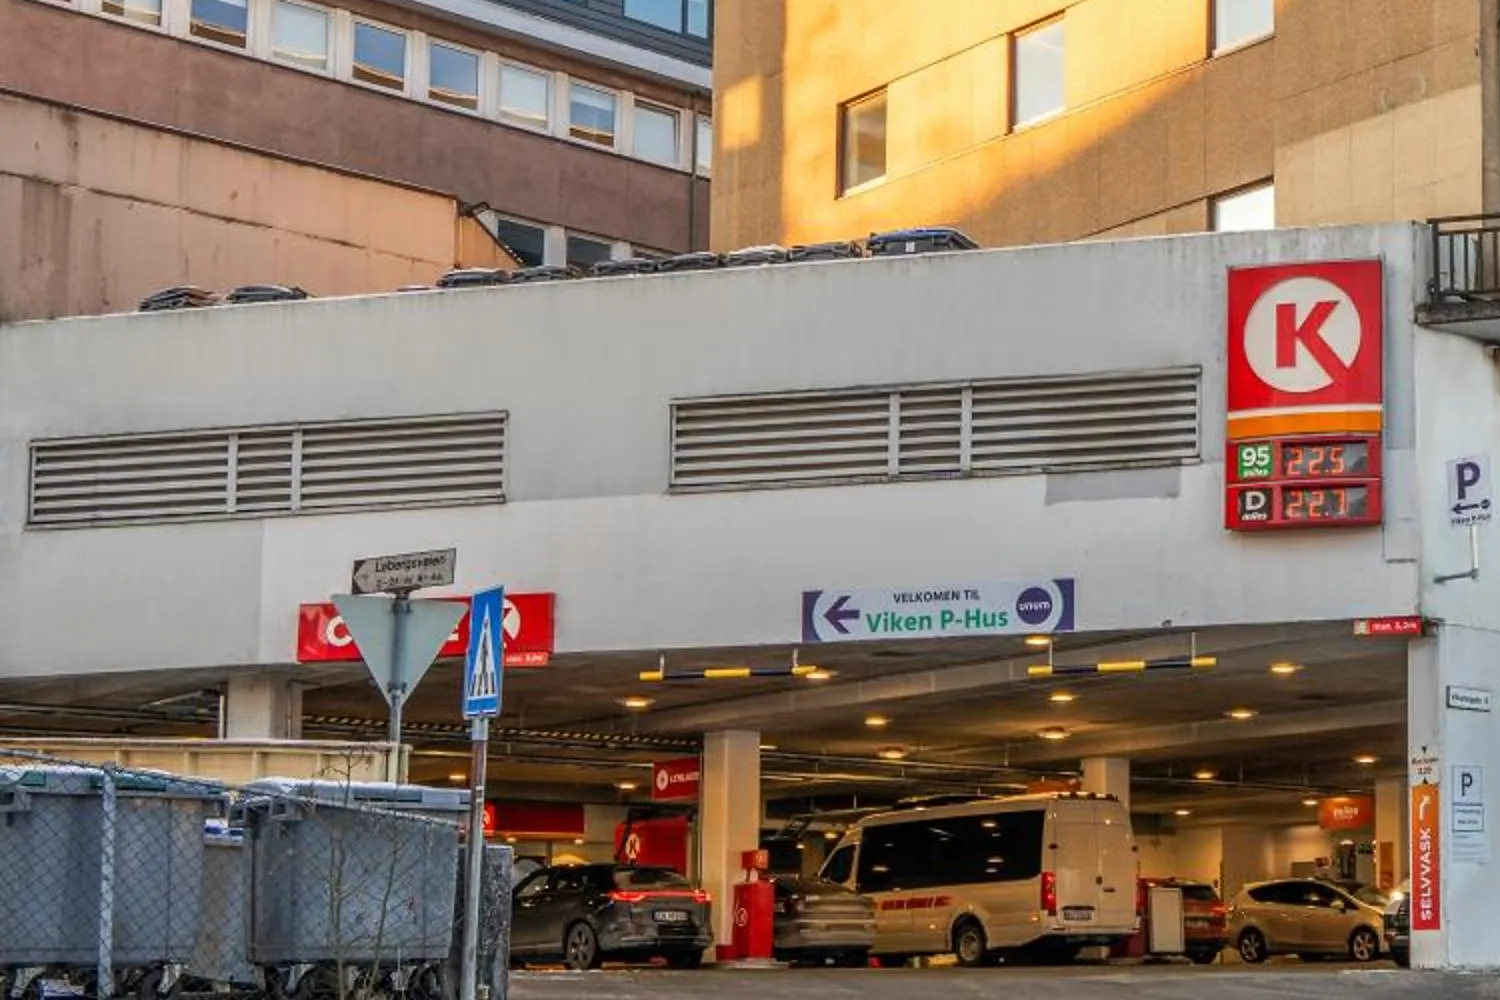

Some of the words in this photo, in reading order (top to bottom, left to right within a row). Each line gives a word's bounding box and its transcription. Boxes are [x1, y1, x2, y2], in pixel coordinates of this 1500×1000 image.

[1268, 292, 1354, 387] K
[1241, 445, 1271, 467] 95
[1456, 461, 1480, 500] P
[1244, 490, 1267, 512] D
[964, 589, 981, 601] TIL
[865, 612, 932, 633] Viken
[940, 609, 1009, 629] P-Hus
[1461, 773, 1473, 797] P
[1419, 826, 1433, 921] SELVVASK
